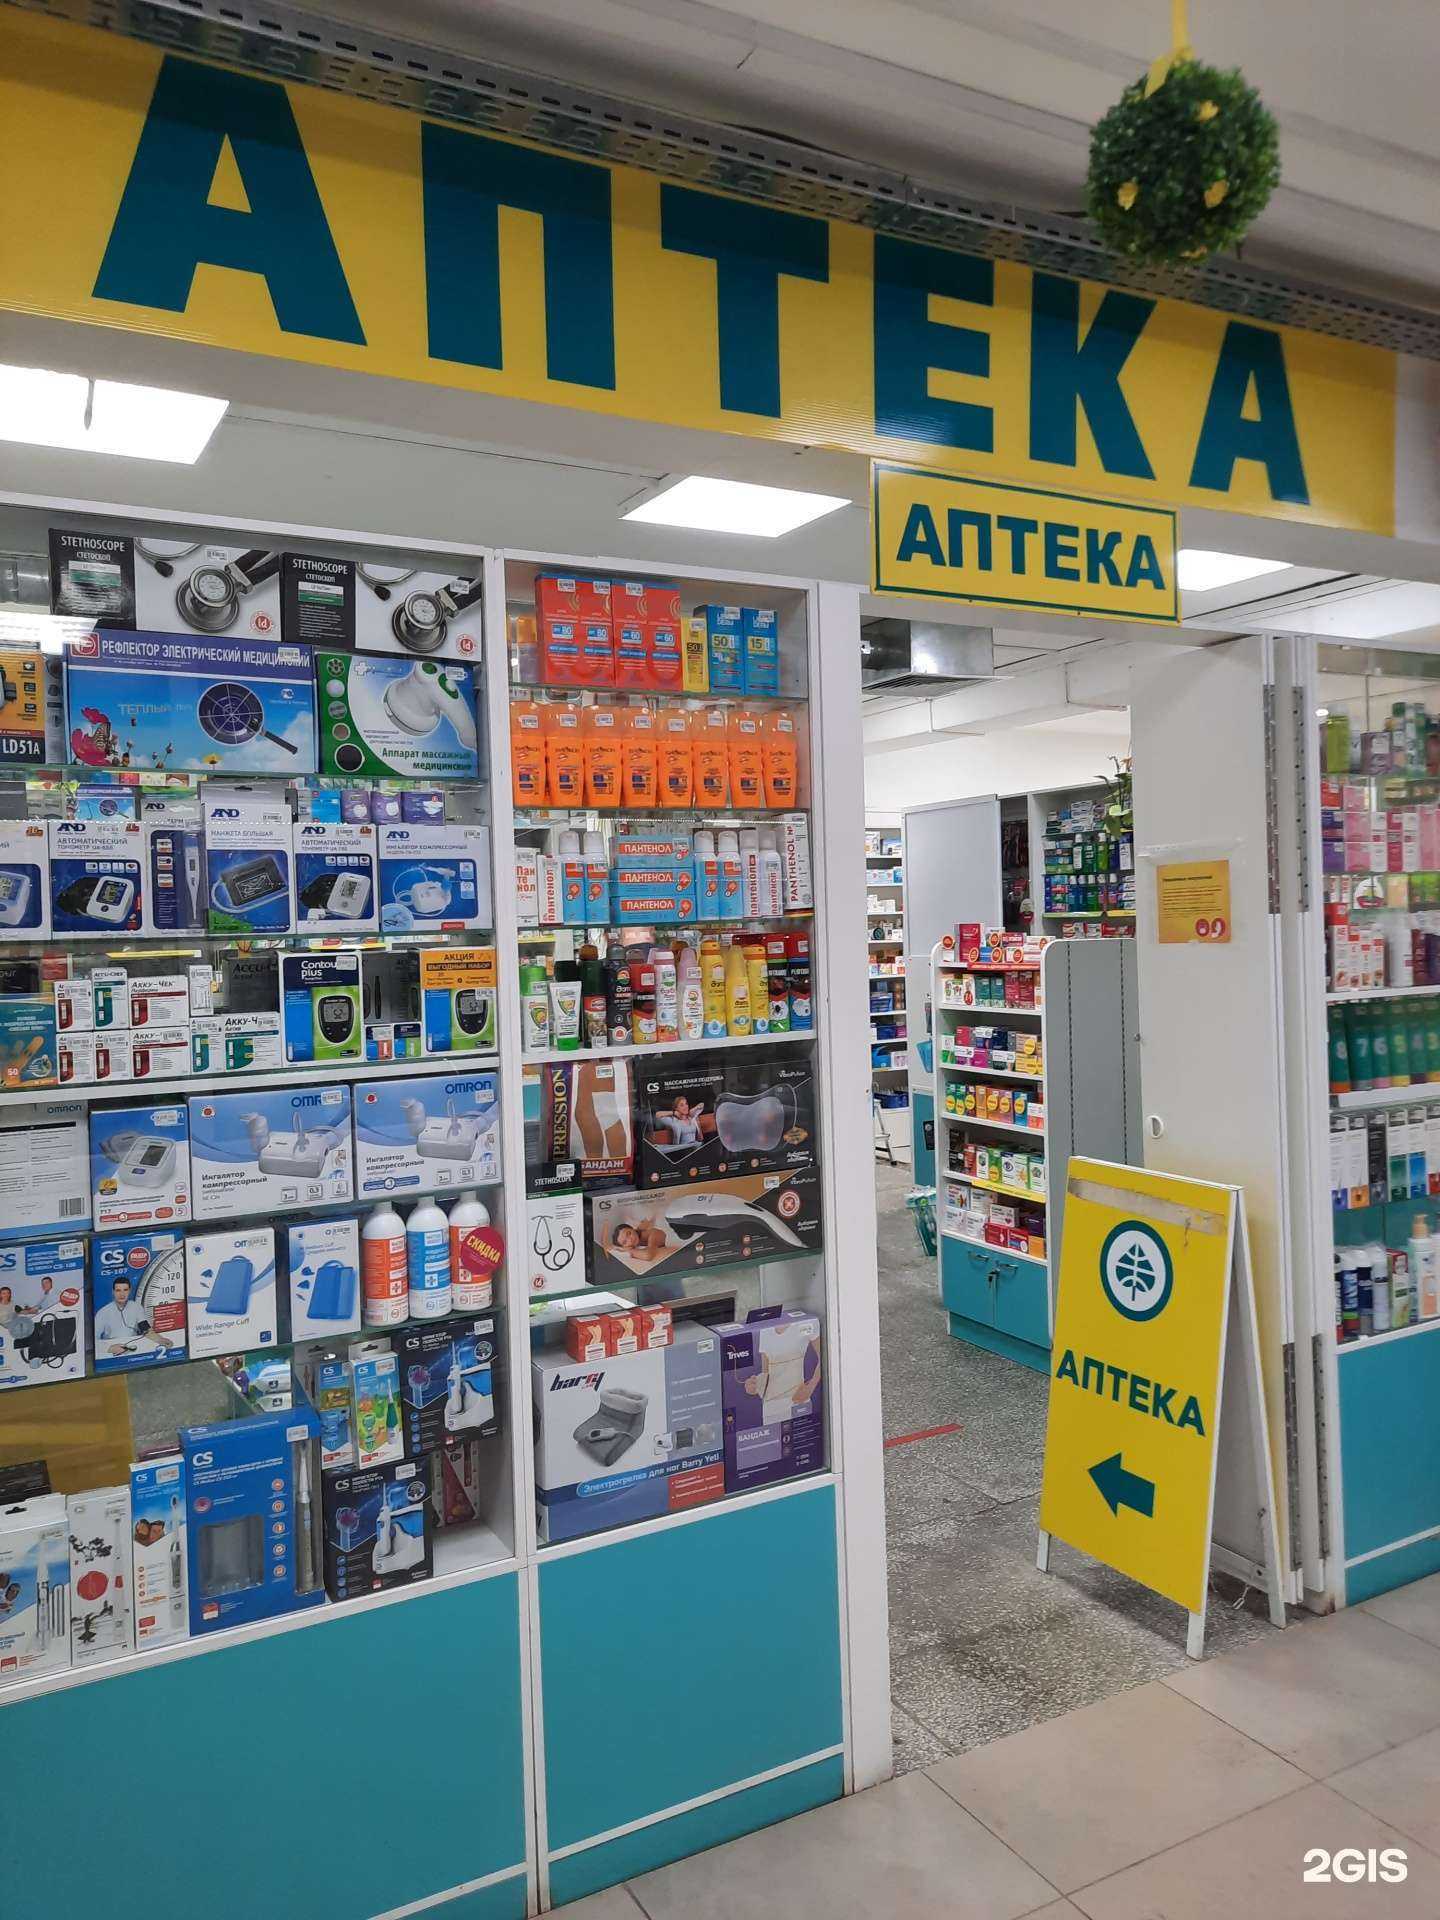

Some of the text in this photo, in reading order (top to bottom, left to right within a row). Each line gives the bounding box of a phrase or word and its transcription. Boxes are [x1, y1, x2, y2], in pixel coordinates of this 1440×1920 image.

[91, 53, 1311, 506] АПТЕКА
[61, 535, 125, 552] STETHOSCOPE
[896, 502, 1167, 592] АПТЕКА
[292, 558, 349, 575] STETHOSCOPE
[305, 572, 336, 583] СТЕТОСКОП
[713, 636, 728, 646] 50
[752, 638, 762, 649] 15
[102, 639, 160, 658] РЕФЛЕКТОР
[162, 645, 241, 664] ЭЛЕКТРИЧЕСКИЙ
[382, 747, 420, 760] Аппарат
[210, 808, 240, 818] AND
[56, 823, 86, 832] AND
[300, 826, 326, 835] AND
[385, 830, 410, 839] AND
[56, 837, 128, 846] АВТОМАТИЧЕСКИЙ
[624, 844, 672, 854] ПАНТЕНОЛ
[516, 865, 536, 876] Пан
[787, 838, 799, 902] PANTHENOL
[625, 873, 672, 883] ПАНТЕНОЛ
[517, 884, 536, 893] нол
[626, 900, 673, 910] ПАНТЕНОЛ
[443, 953, 475, 962] АКЦИЯ
[301, 960, 337, 970] Contou
[301, 969, 323, 980] plus
[1357, 1037, 1368, 1057] 7
[1373, 1036, 1388, 1055] 6
[445, 1080, 492, 1095] OMRON
[647, 1082, 660, 1092] CS
[291, 1094, 322, 1108] OMR
[366, 1154, 405, 1164] Ингалятор
[366, 1160, 425, 1171] компрессорный
[202, 1170, 245, 1181] Ингалятор
[534, 1176, 572, 1186] STETHOSCOPE
[202, 1176, 267, 1189] компрессорный
[598, 1201, 611, 1210] CS
[467, 1235, 501, 1264] СКИДКА
[101, 1249, 125, 1265] CS
[167, 1272, 180, 1280] 120
[162, 1287, 175, 1295] 100
[214, 1321, 234, 1330] Range
[405, 1337, 420, 1348] CS
[155, 1345, 167, 1360] 2
[727, 1350, 750, 1360] Trives
[358, 1366, 369, 1374] CS
[550, 1372, 606, 1392] barry
[1056, 1349, 1206, 1437] АПТЕКА
[192, 1451, 213, 1467] CS
[136, 1473, 148, 1482] CS
[583, 1472, 648, 1494] Электрогрелка
[666, 1465, 681, 1473] ног
[682, 1458, 704, 1471] Barry
[705, 1453, 720, 1462] Yeti
[335, 1479, 350, 1490] CS
